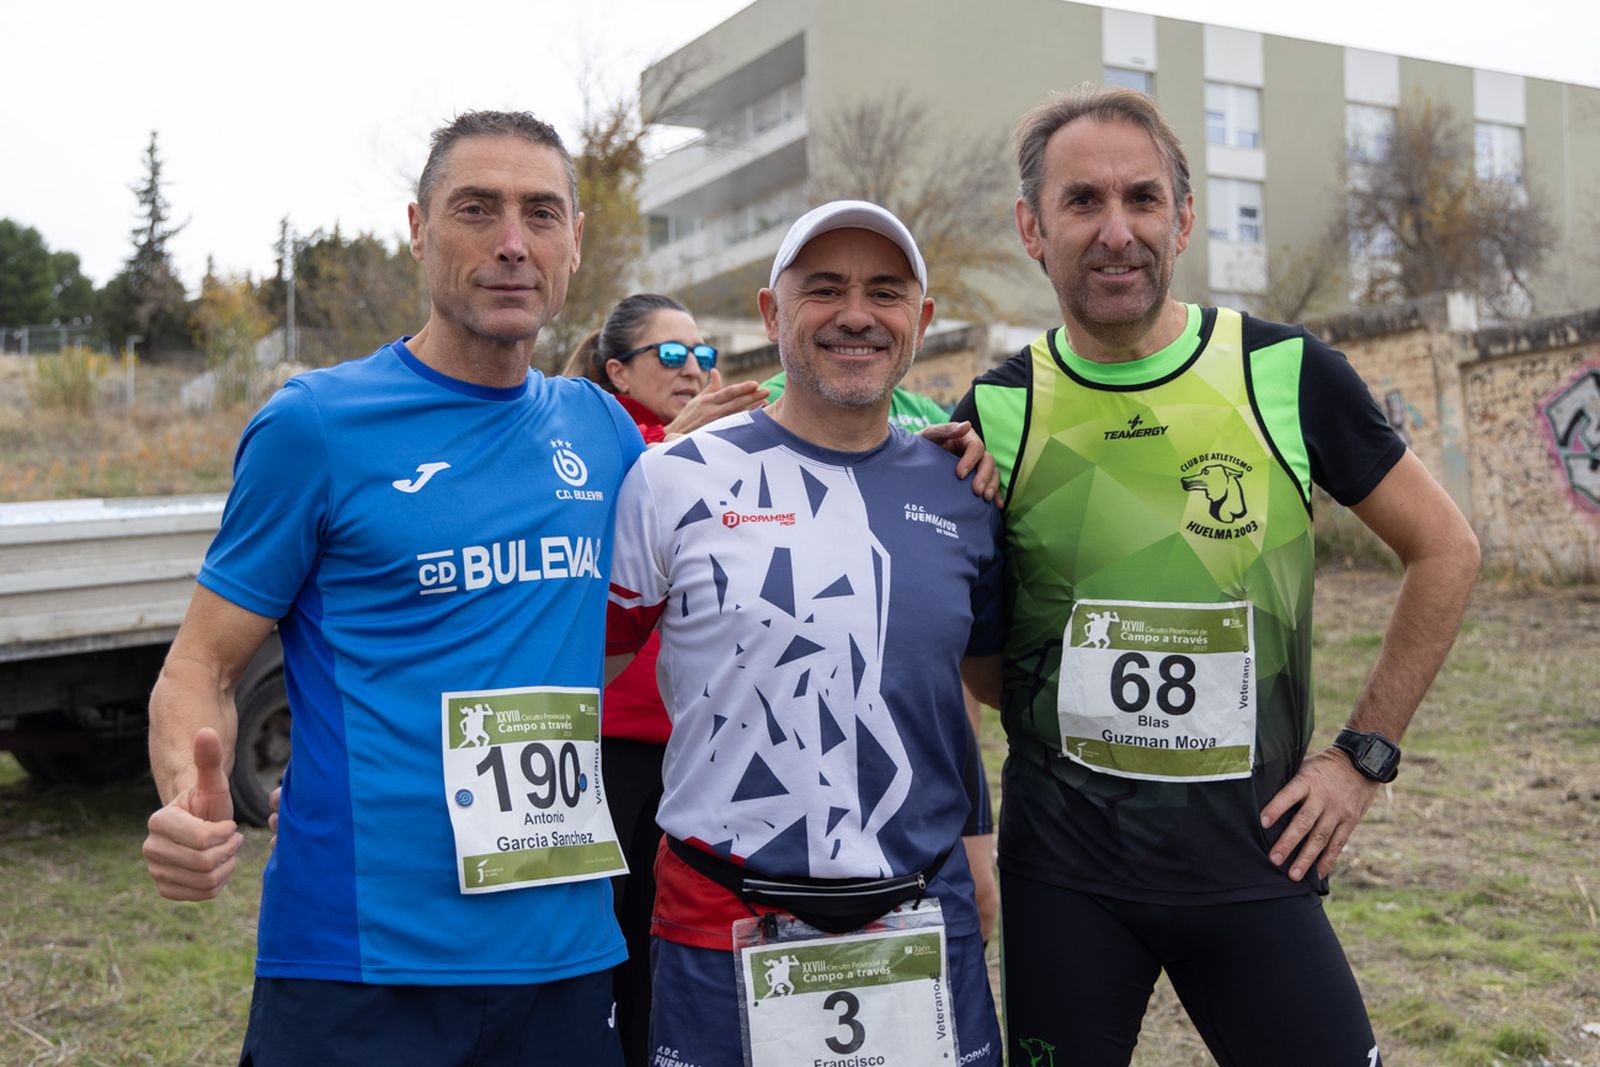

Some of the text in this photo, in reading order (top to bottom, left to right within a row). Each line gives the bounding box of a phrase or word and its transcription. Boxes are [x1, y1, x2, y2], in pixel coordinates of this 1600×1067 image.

[1103, 425, 1169, 440] TEAMERGY
[1180, 452, 1253, 473] CLUB DE ATLETISMO
[741, 513, 796, 523] DOPAMINE
[905, 510, 957, 534] FUENMAYOR
[1186, 520, 1258, 540] HUELMA 2003
[418, 561, 457, 587] CD
[1120, 620, 1145, 632] XXVIII
[1120, 632, 1208, 644] Campo a través
[1110, 651, 1196, 716] 68
[1239, 657, 1251, 710] Veterano
[495, 710, 521, 724] XXVIII
[498, 720, 573, 734] Campo a través
[1137, 715, 1170, 729] Blas
[1102, 729, 1216, 752] Guzman Moya
[476, 741, 581, 813] 190
[592, 748, 602, 805] Veterano
[523, 810, 565, 826] Antonio
[496, 830, 595, 852] Garcia Sanchez
[802, 960, 827, 973] XXVIII
[803, 966, 892, 983] Campo a través
[933, 984, 946, 1041] Veterano
[822, 991, 866, 1055] 3
[814, 1055, 885, 1067] Francisco
